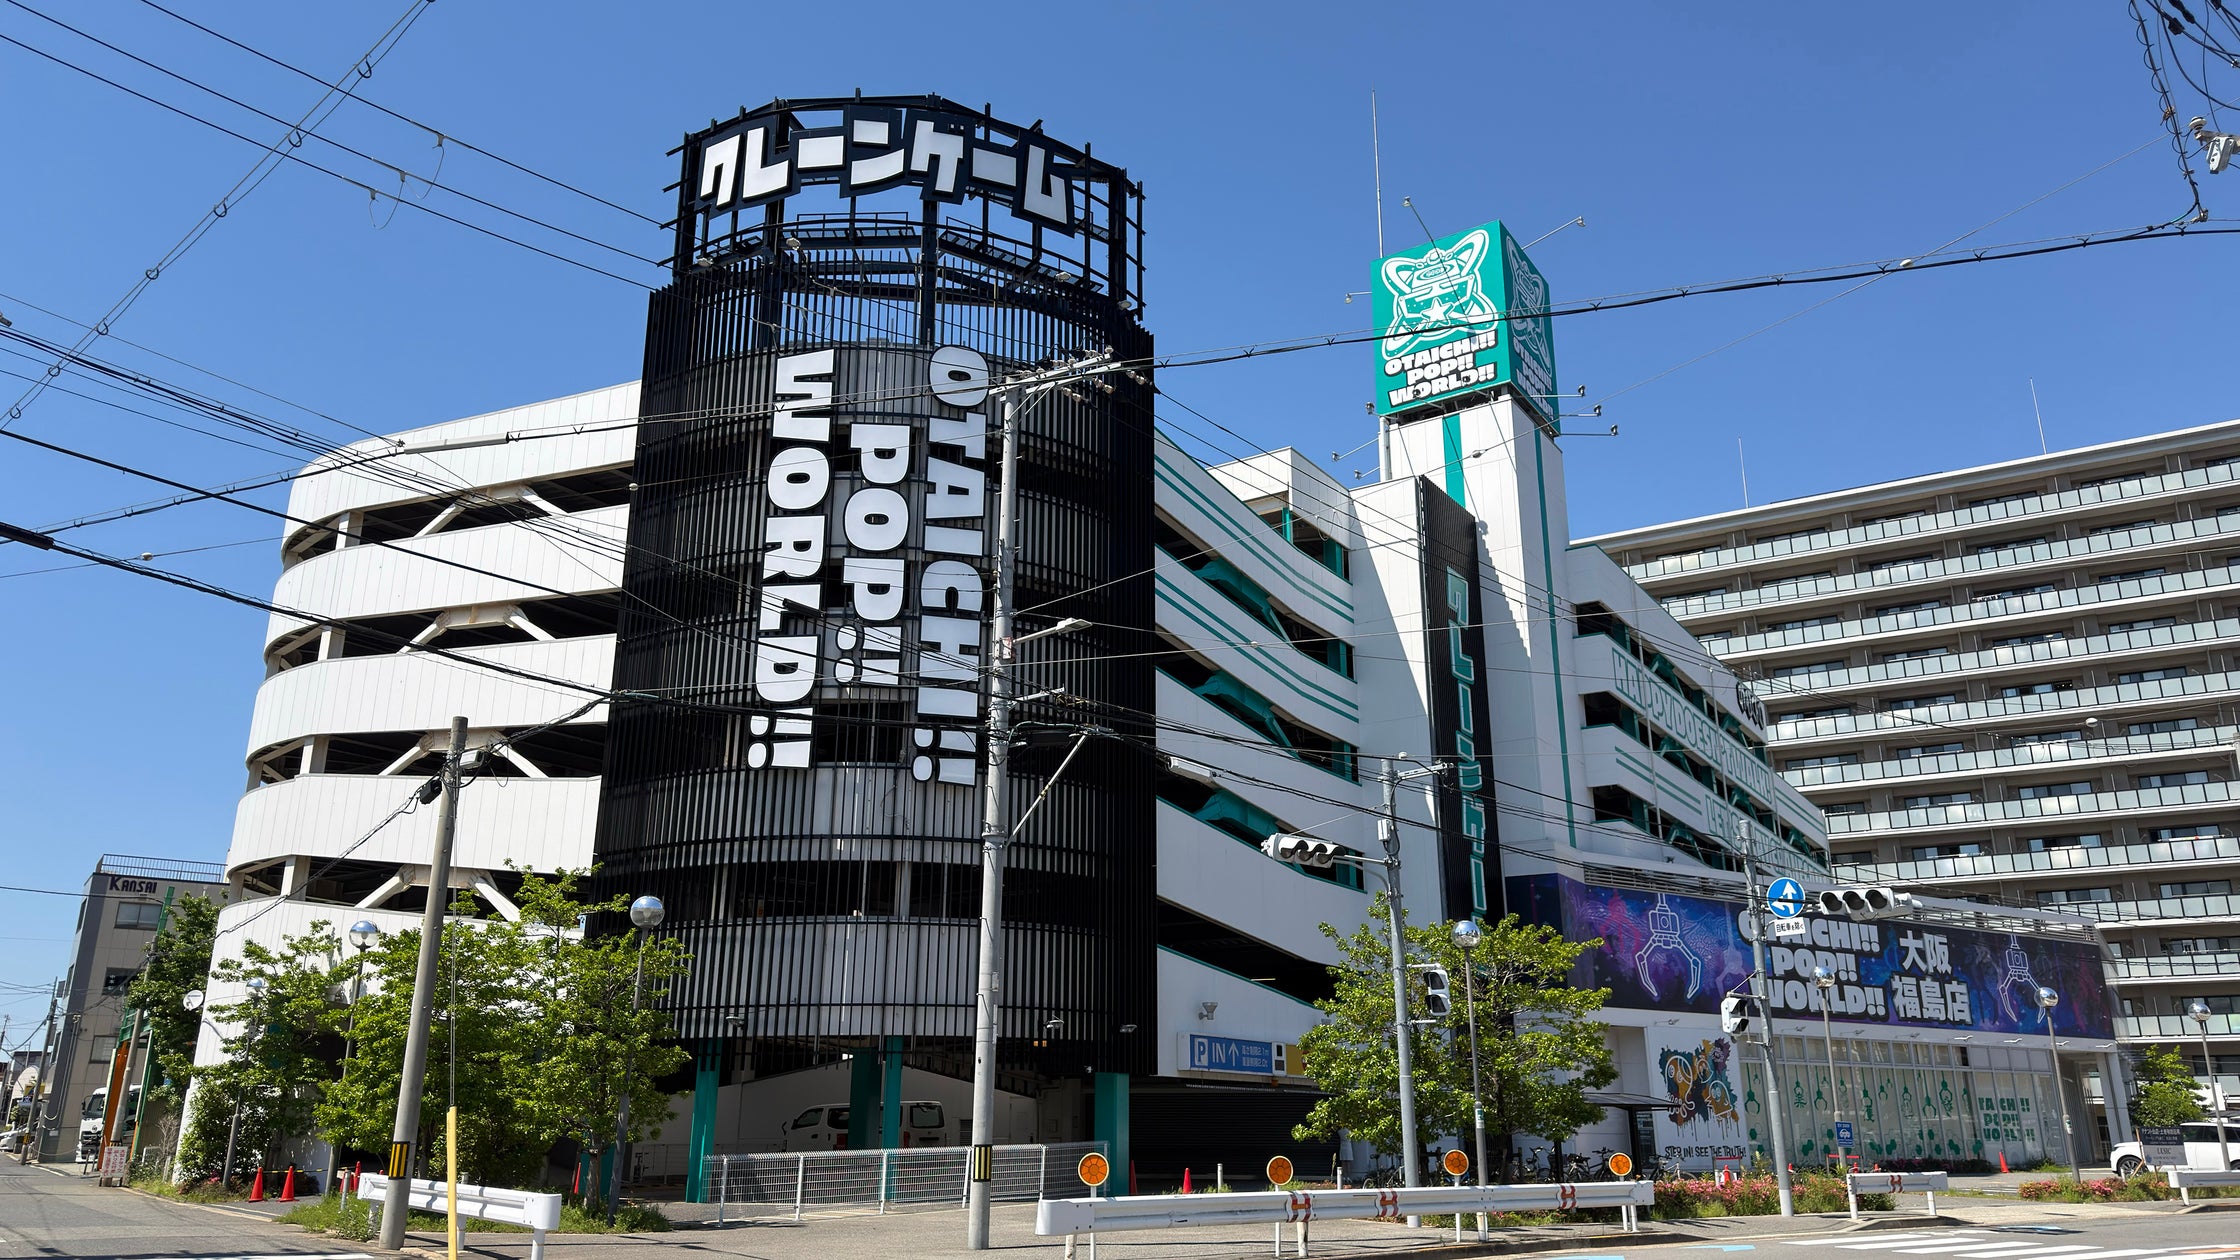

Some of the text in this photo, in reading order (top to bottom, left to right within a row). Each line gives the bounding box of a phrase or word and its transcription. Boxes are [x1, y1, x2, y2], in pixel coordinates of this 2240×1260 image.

[700, 119, 1068, 223] クレーンゲーム
[1384, 331, 1495, 375] OTAICHI!!
[1407, 352, 1473, 385] POP!!
[1389, 363, 1495, 406] WORLD!!
[747, 348, 835, 769] WORLD!!
[836, 423, 910, 685] POP!!
[912, 345, 990, 786] OTAICHI!!
[1447, 564, 1489, 932] クレーンゲー
[1771, 946, 1858, 982] POP!!
[1900, 929, 1952, 975] 大阪
[1892, 975, 1973, 1025] 福島店
[1212, 1042, 1225, 1064] IN
[1695, 1146, 1708, 1157] SEE
